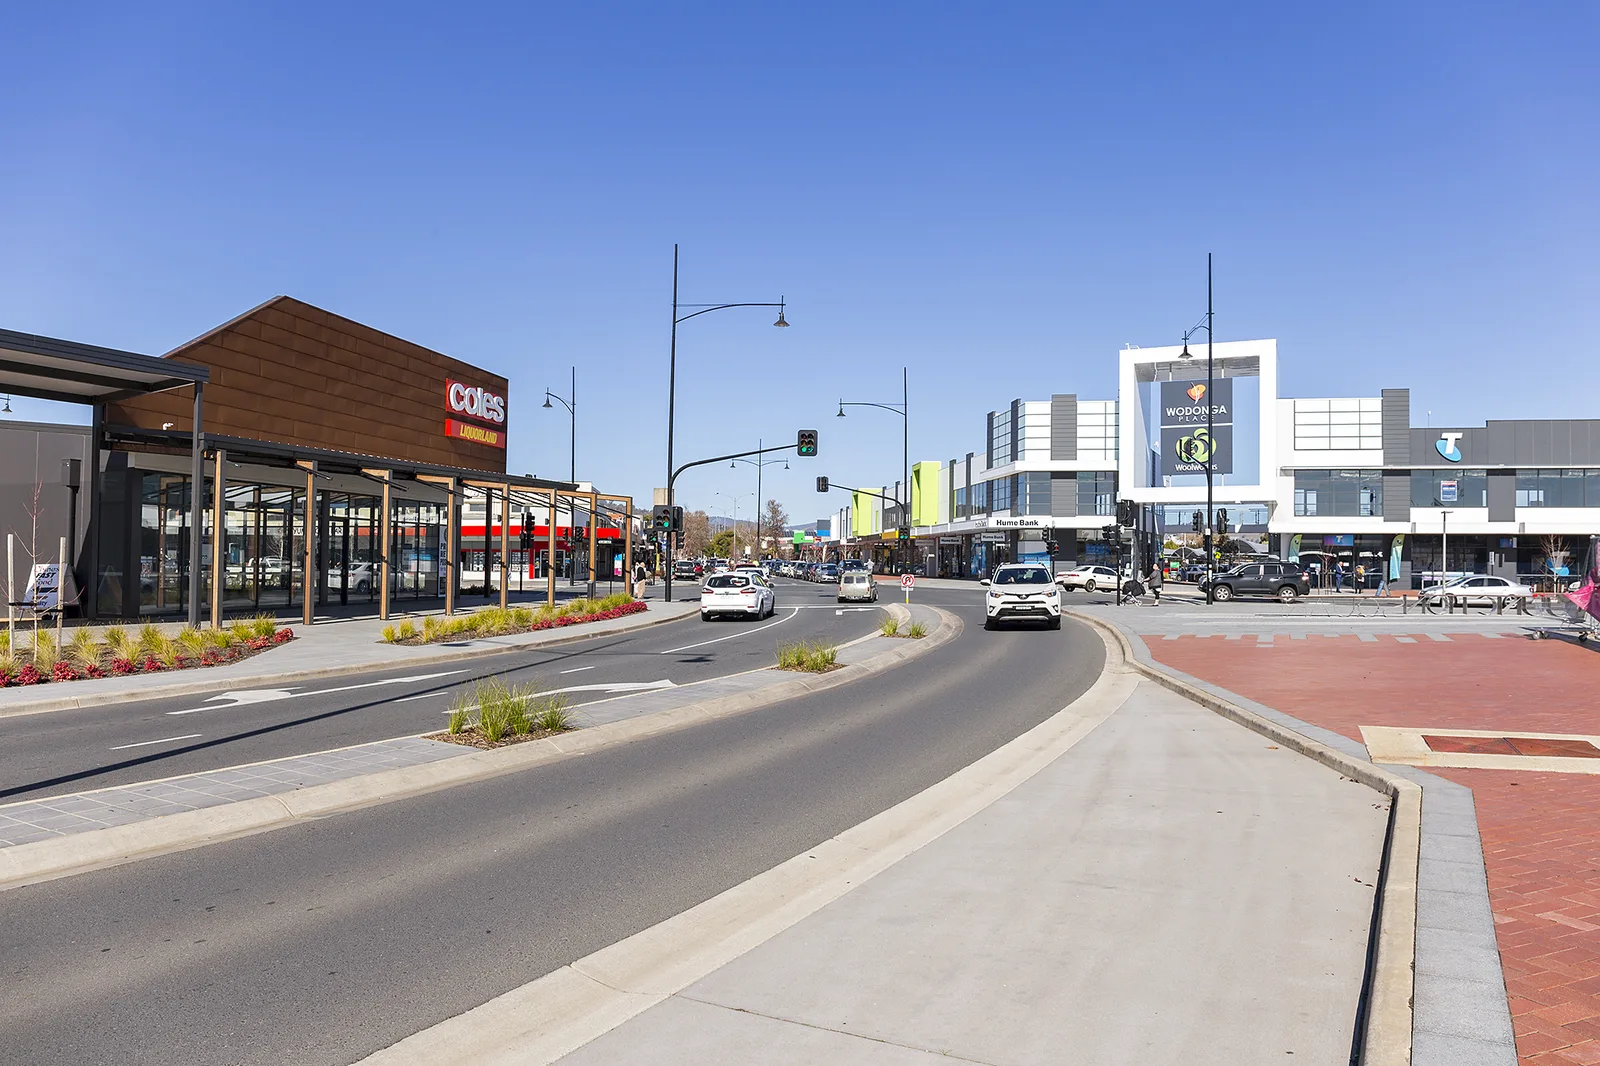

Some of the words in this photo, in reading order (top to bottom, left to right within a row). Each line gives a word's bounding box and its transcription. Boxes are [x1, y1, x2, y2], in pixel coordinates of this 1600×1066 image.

[449, 383, 505, 423] coles
[1166, 405, 1227, 417] WODONGA
[459, 424, 498, 444] LIQUORLAND
[1174, 463, 1218, 472] Woolwots
[996, 519, 1019, 527] Hume
[1019, 519, 1039, 527] Bank
